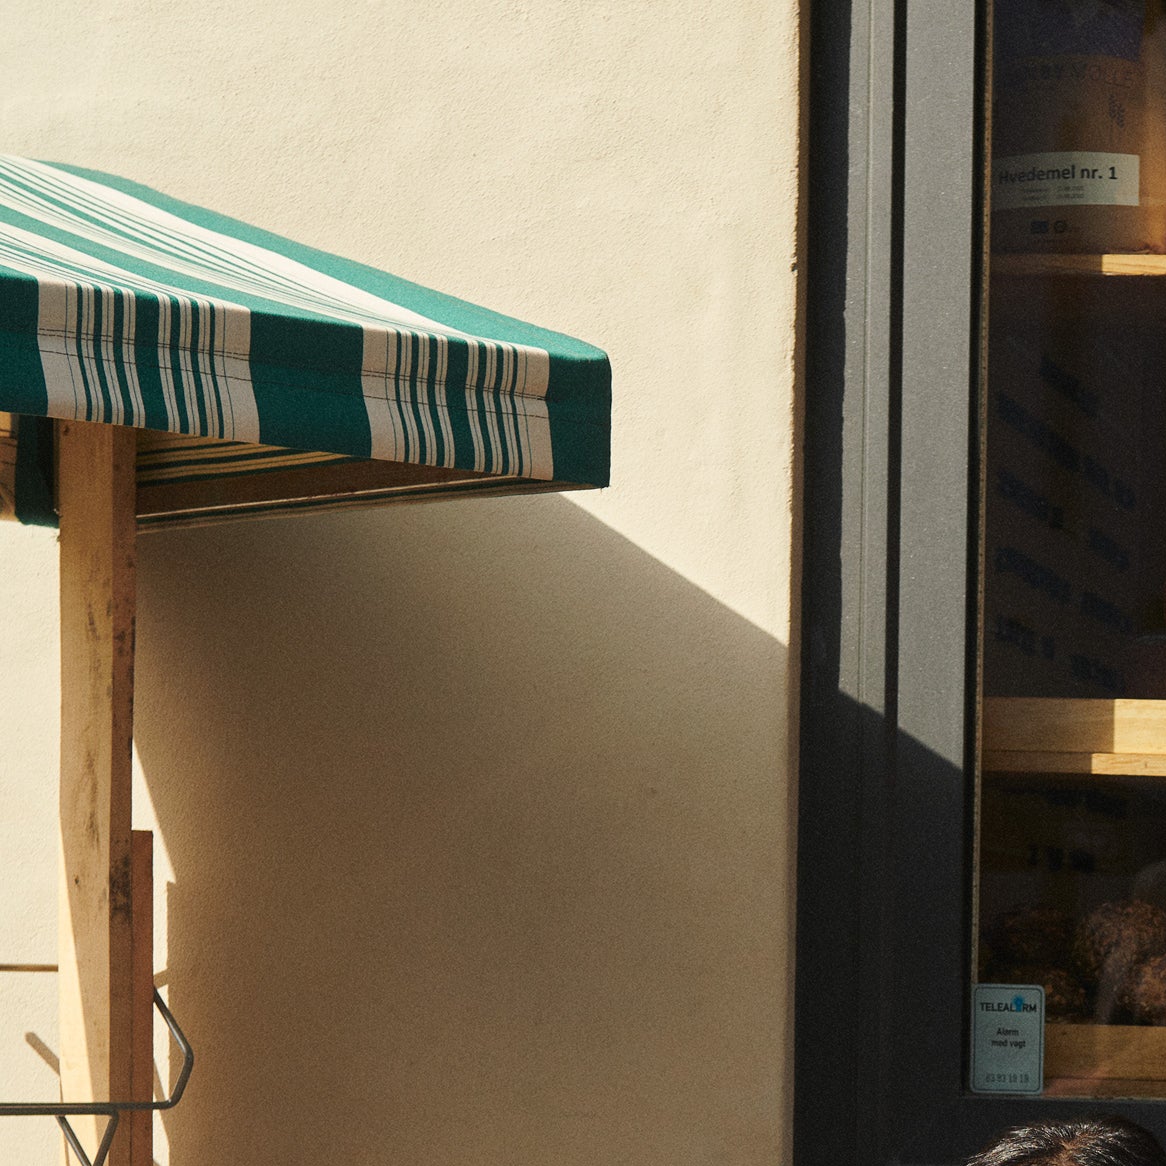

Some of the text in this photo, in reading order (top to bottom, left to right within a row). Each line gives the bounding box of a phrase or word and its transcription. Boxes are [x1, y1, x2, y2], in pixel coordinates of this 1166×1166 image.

[1000, 165, 1118, 183] Hvedemel nr. 1
[996, 1027, 1019, 1036] Alarm
[991, 1039, 1026, 1049] med vagt
